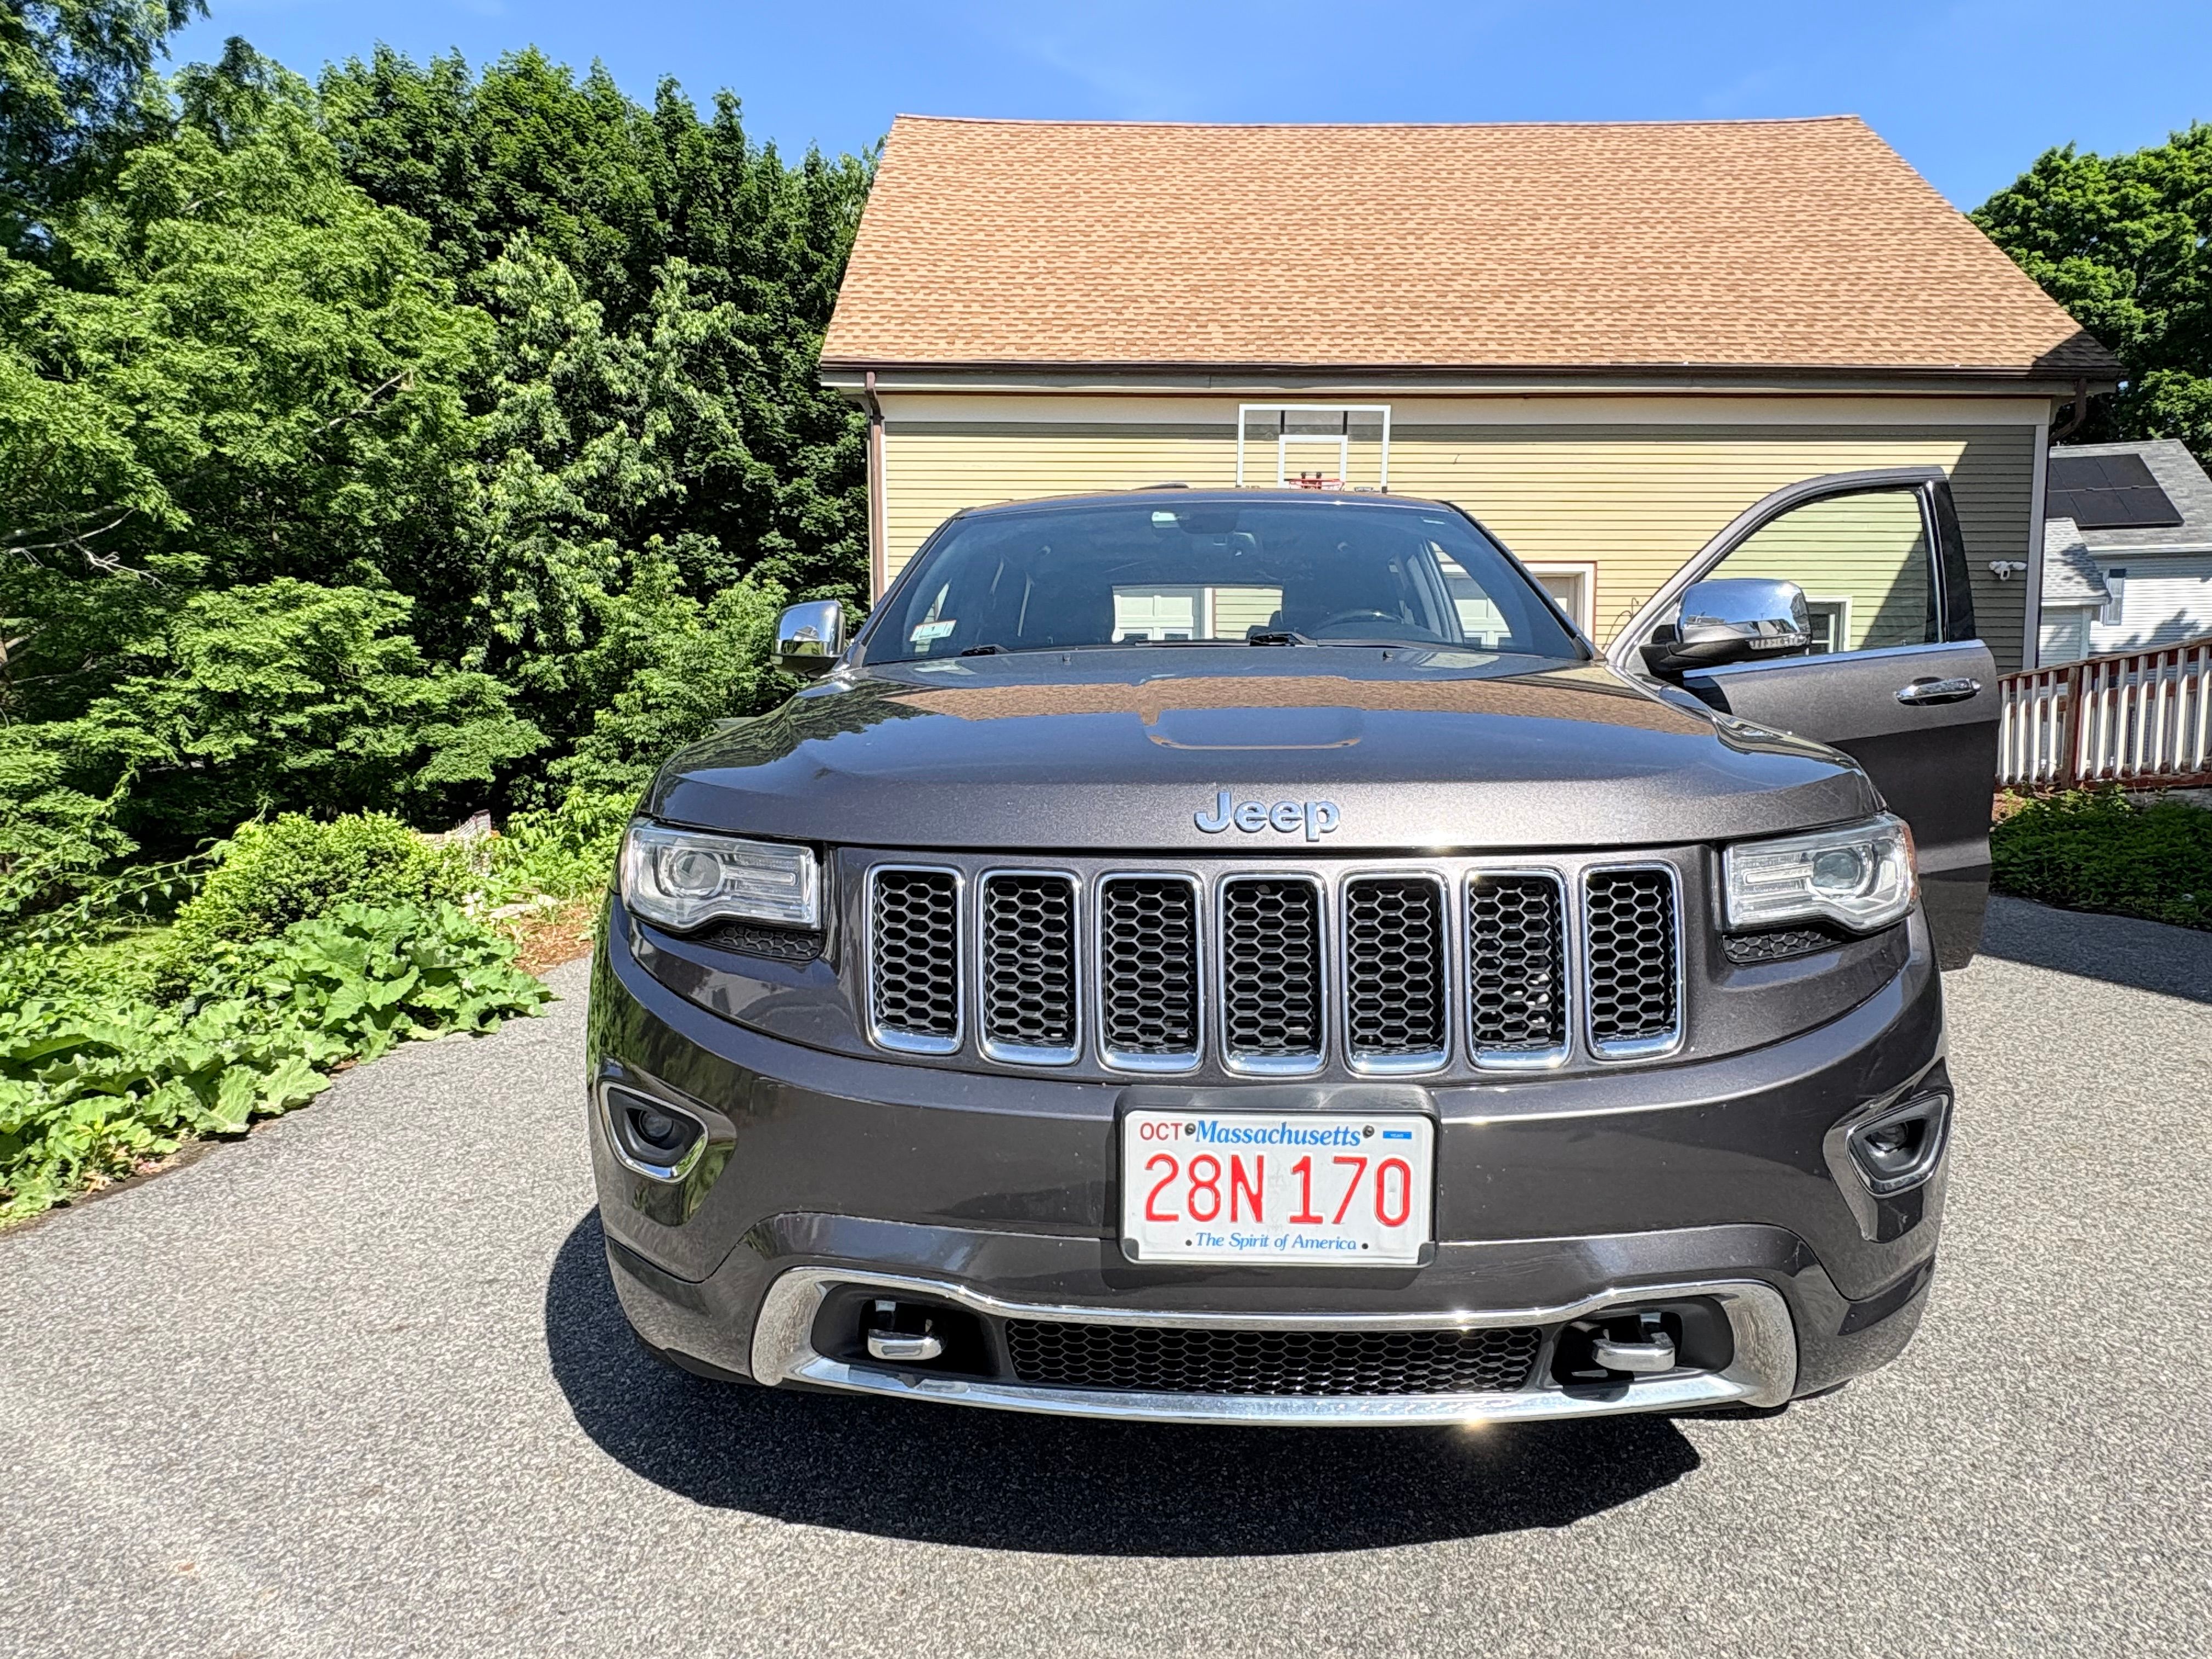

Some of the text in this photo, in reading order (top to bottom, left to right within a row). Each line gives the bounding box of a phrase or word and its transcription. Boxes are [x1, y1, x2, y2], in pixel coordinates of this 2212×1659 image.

[1194, 791, 1340, 842] Jeep
[1139, 1122, 1183, 1141] OCT
[1195, 1120, 1361, 1146] Massachusetts
[1144, 1154, 1412, 1227] 28N 170
[1196, 1232, 1357, 1250] The Spirit of America
